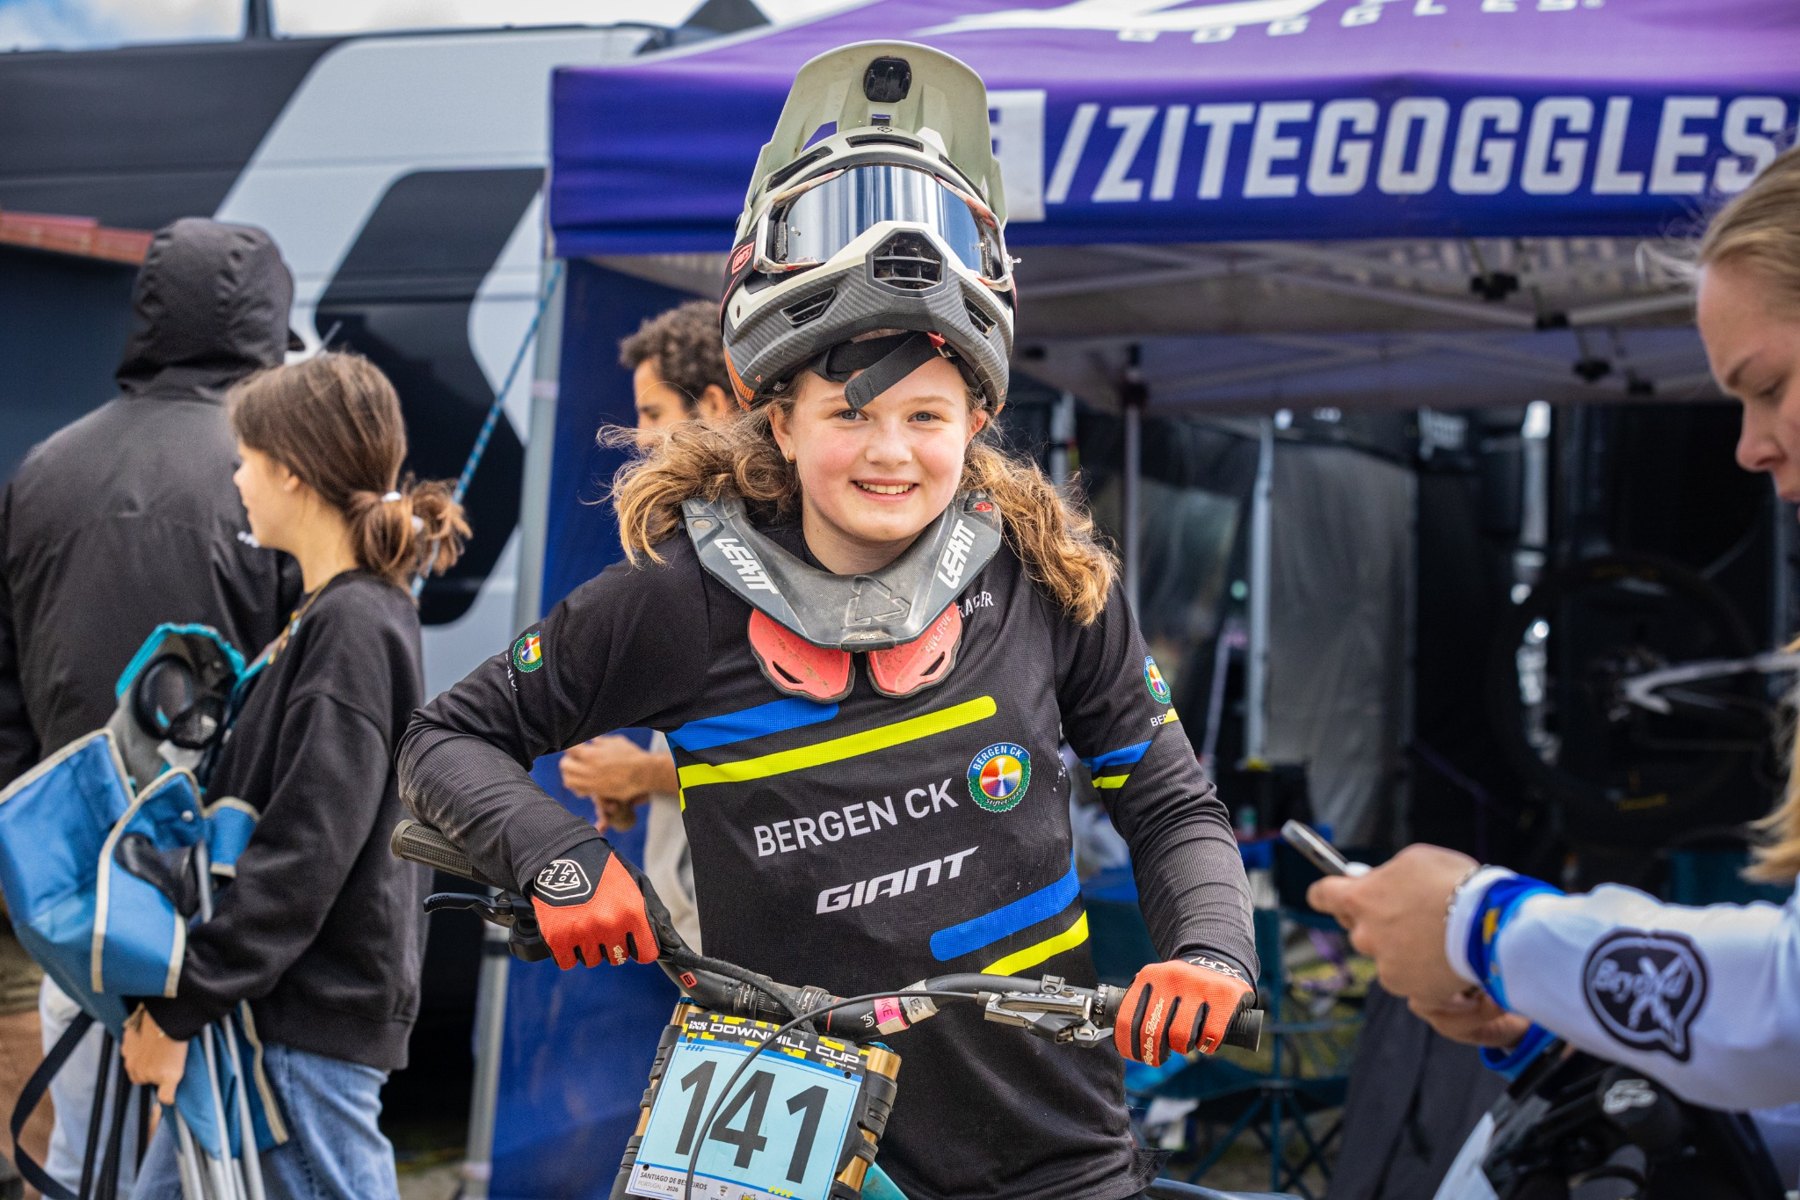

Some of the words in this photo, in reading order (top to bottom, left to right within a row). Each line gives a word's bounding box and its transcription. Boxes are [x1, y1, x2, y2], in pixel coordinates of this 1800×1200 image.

[713, 537, 778, 595] LEATT
[937, 518, 977, 590] LEATT
[973, 746, 1007, 770] BERGEN
[1009, 746, 1023, 758] CK
[753, 796, 898, 857] BERGEN
[904, 778, 959, 819] CK
[815, 845, 980, 915] GIANT
[815, 1044, 860, 1063] CUP
[674, 1060, 829, 1184] 141
